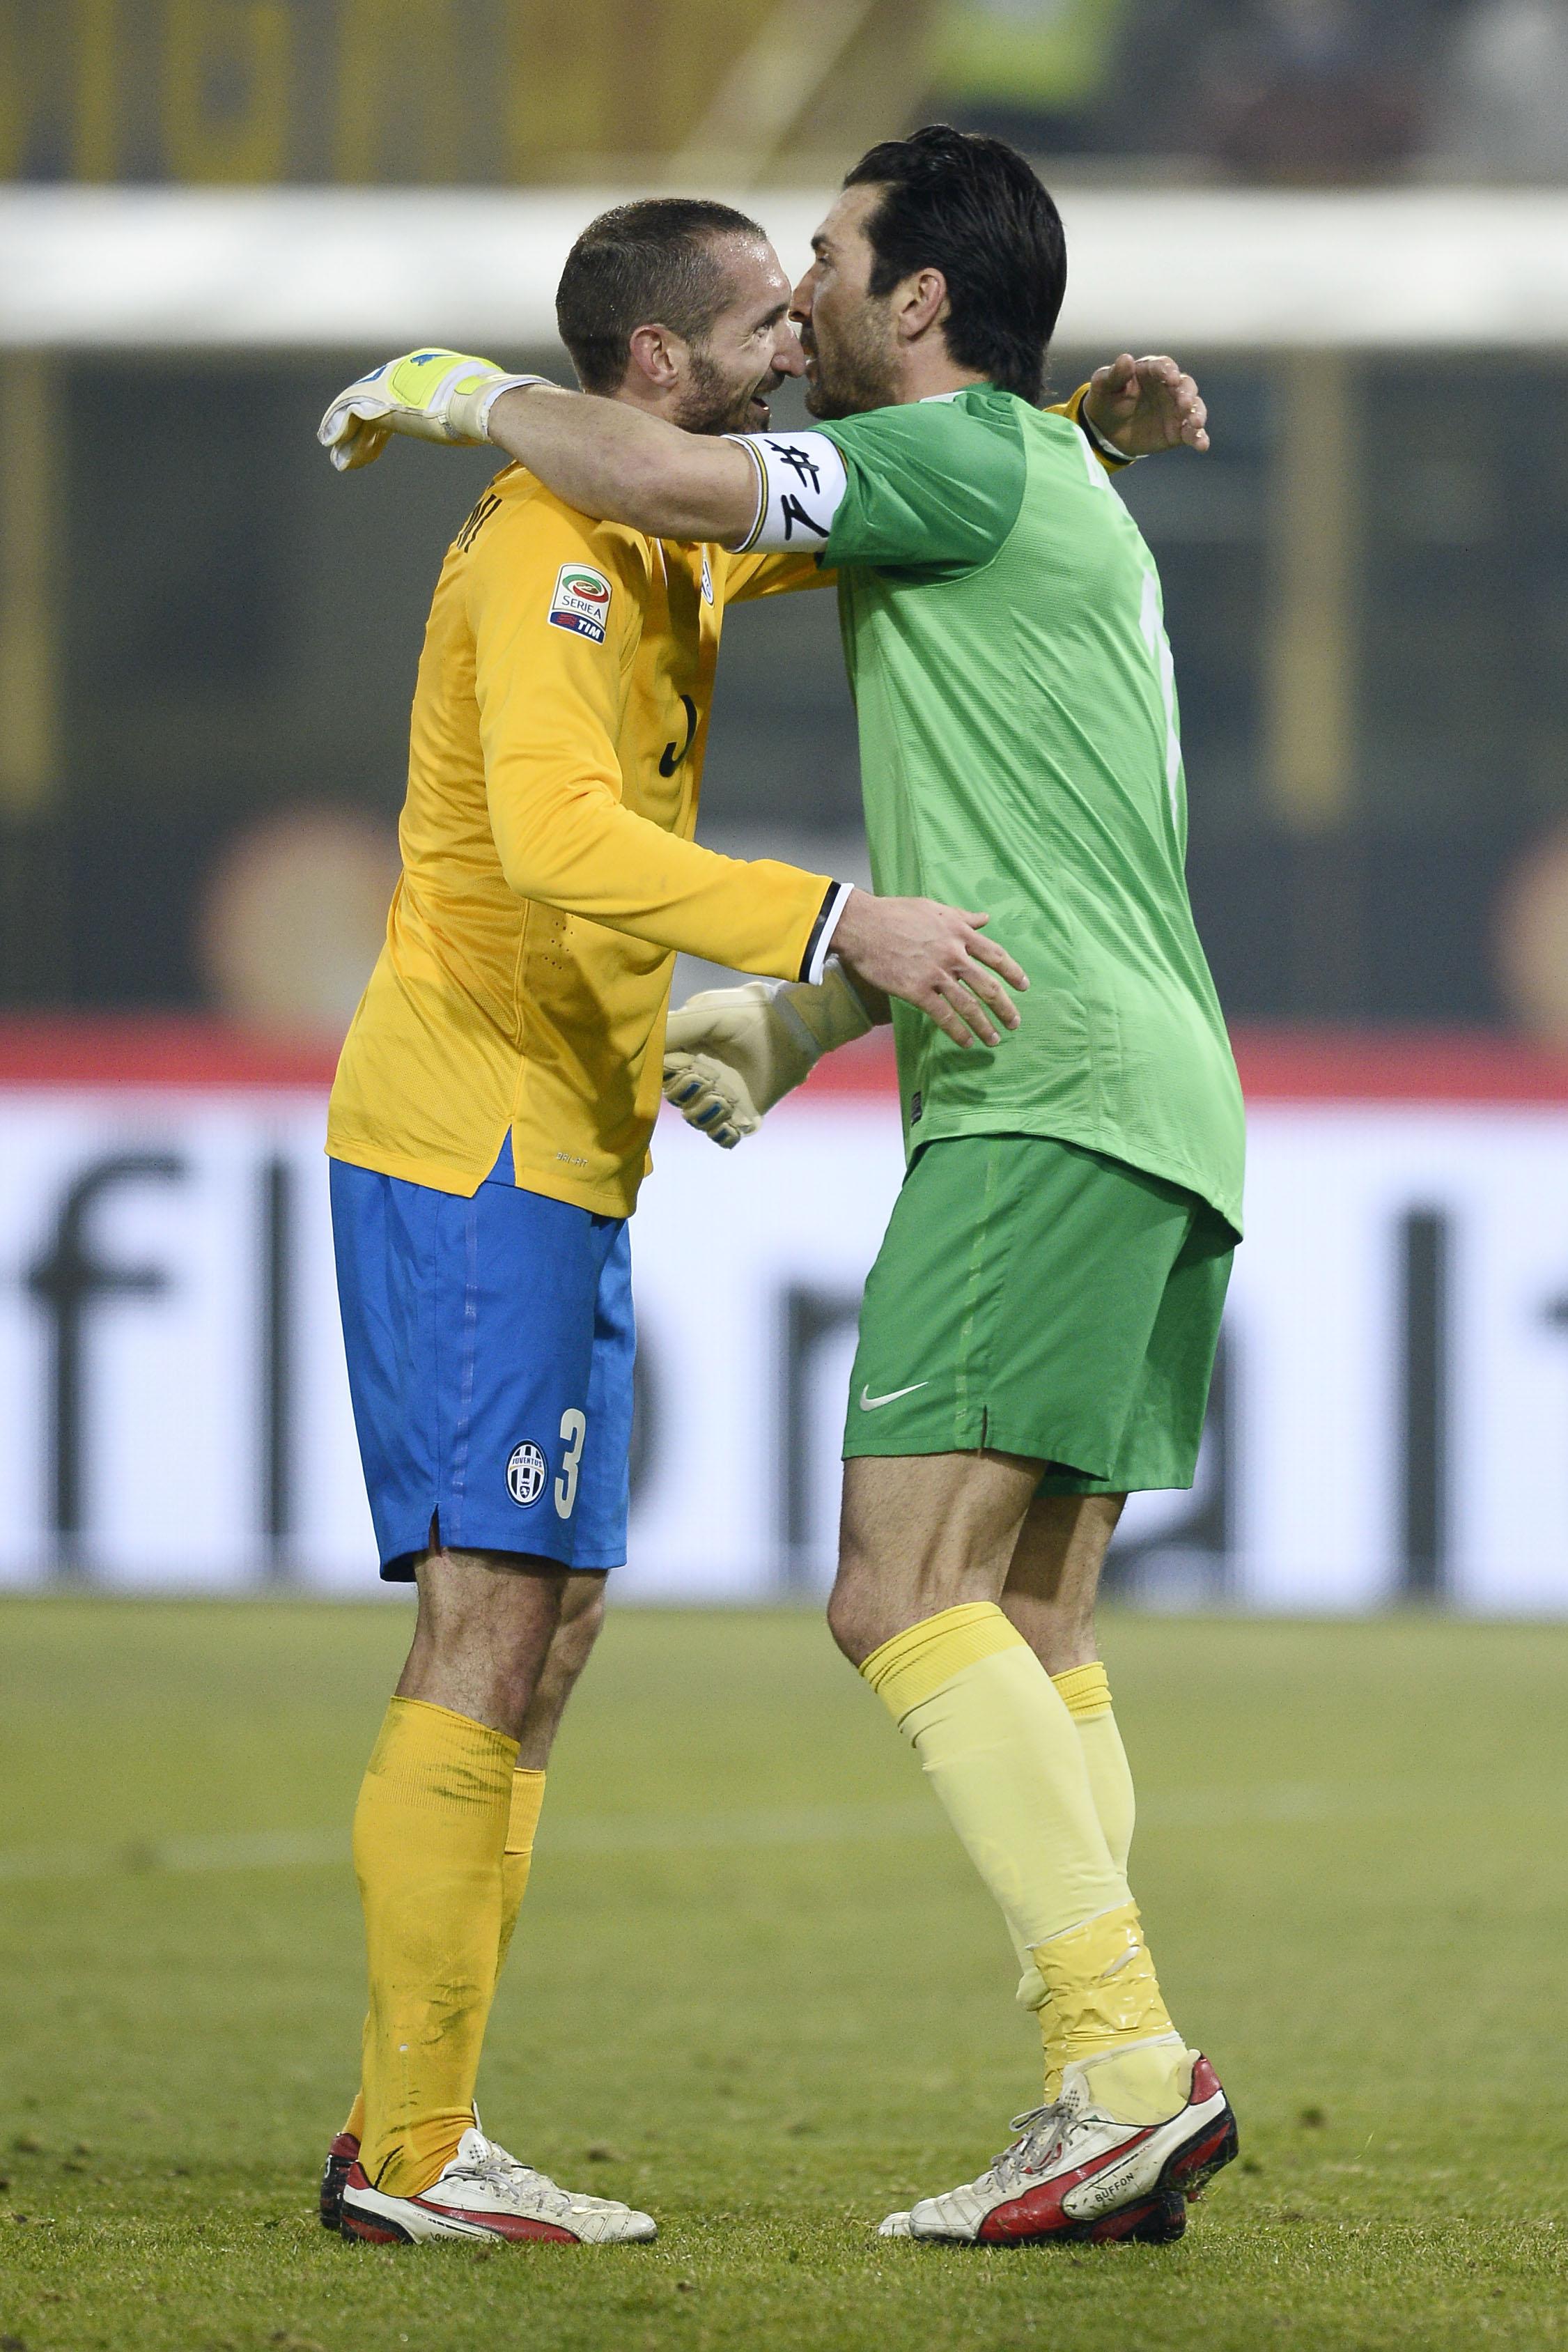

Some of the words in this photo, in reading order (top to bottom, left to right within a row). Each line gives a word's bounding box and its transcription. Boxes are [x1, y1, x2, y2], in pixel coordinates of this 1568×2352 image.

[561, 595, 594, 614] SERIE
[593, 608, 601, 620] A
[577, 619, 601, 639] TIM
[512, 1457, 543, 1468] JUVENTUS
[554, 1408, 586, 1519] 3
[1095, 2172, 1135, 2202] BUFFON
